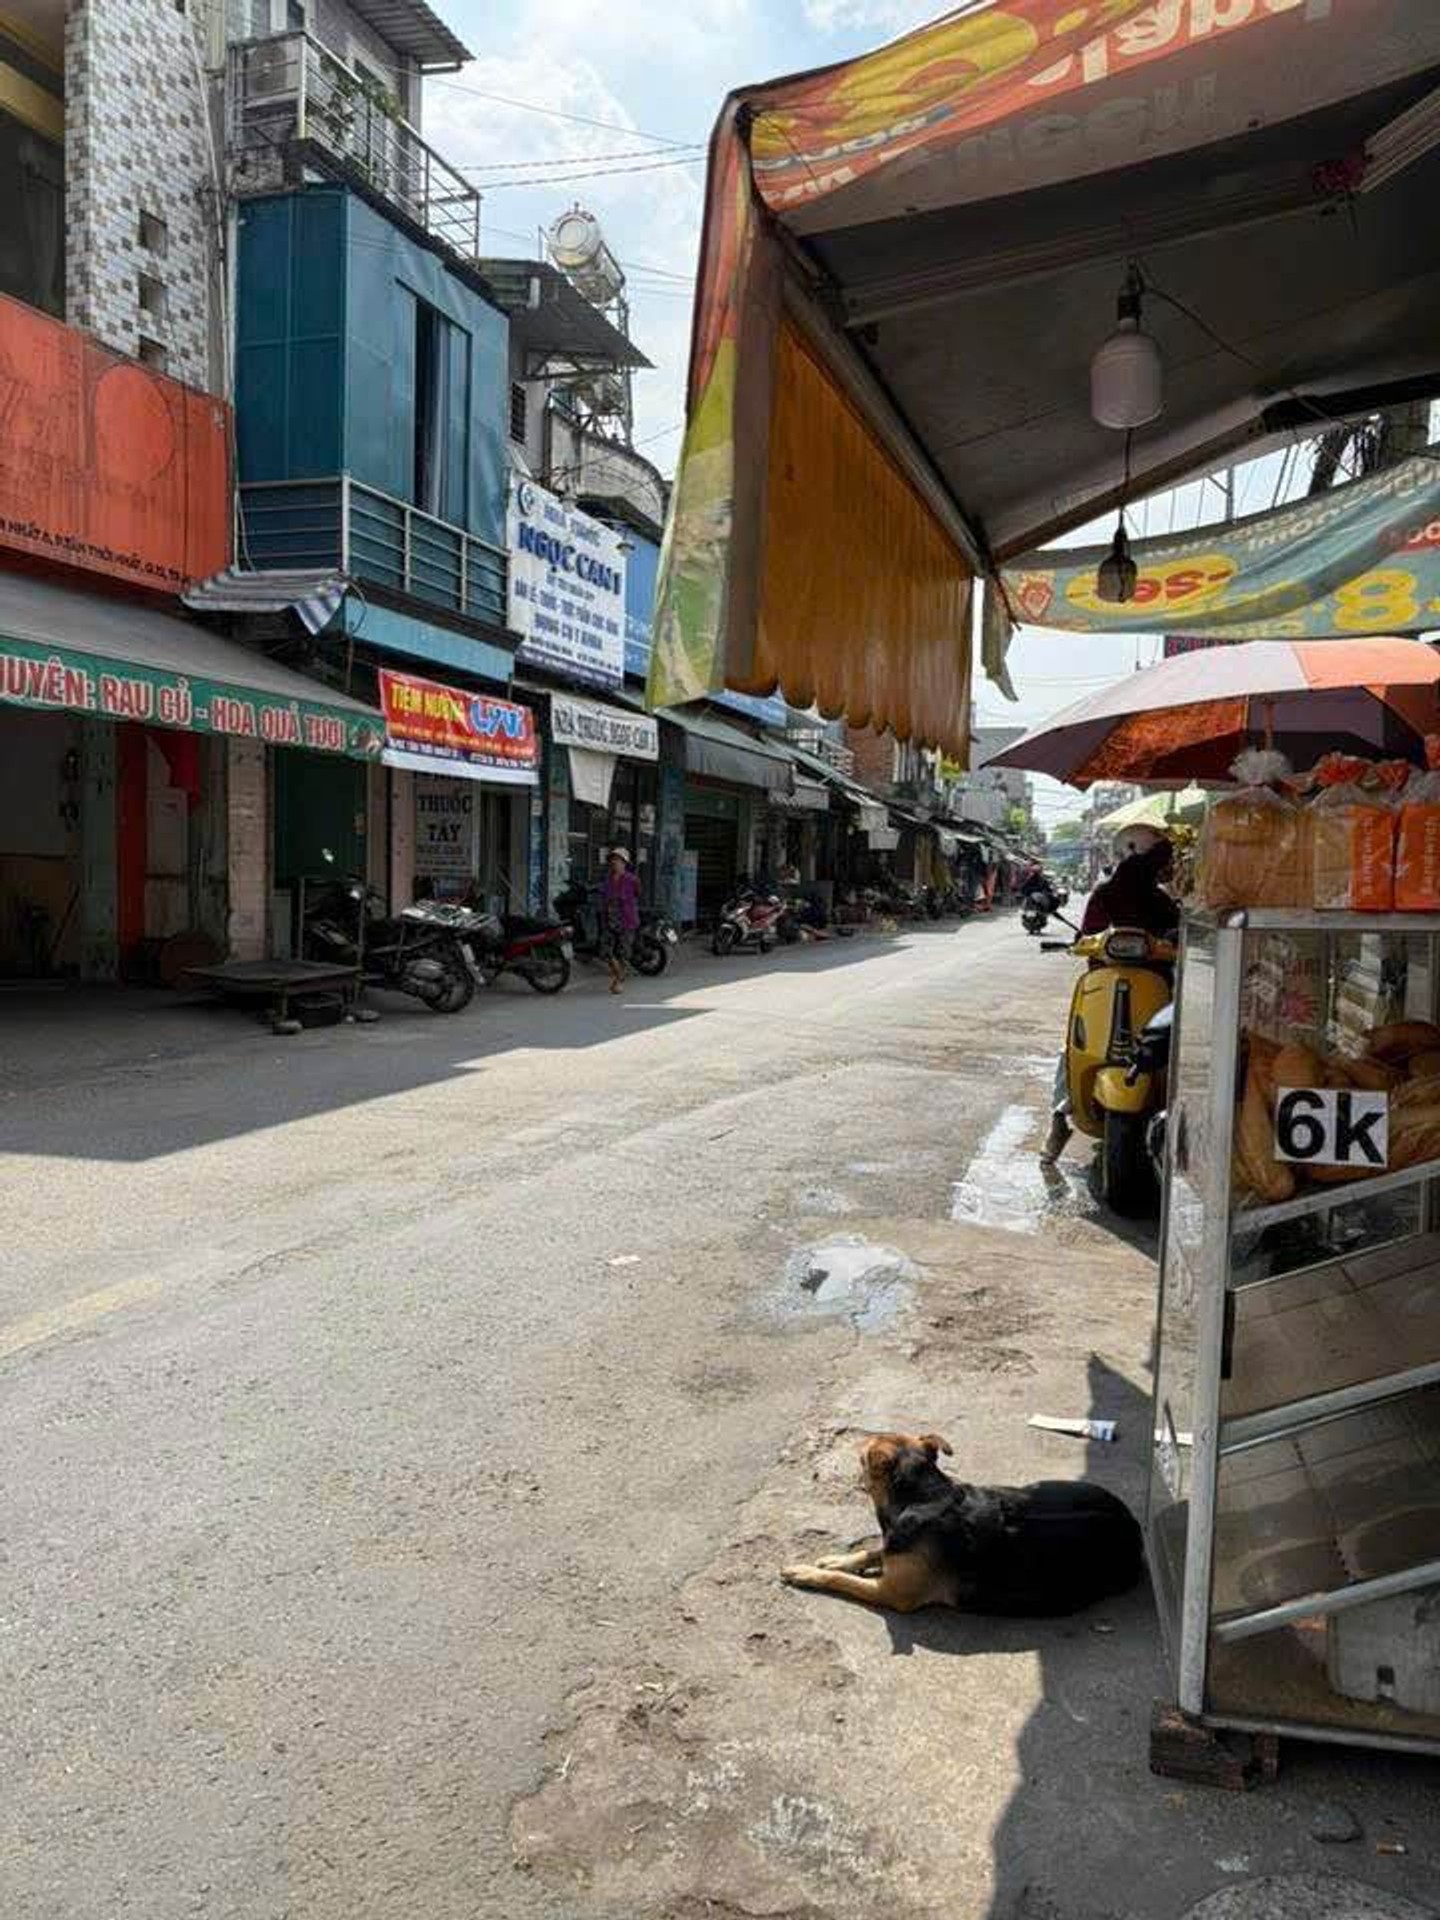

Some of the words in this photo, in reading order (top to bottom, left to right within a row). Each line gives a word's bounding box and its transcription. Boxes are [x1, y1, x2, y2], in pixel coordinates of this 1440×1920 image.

[0, 654, 96, 710] UYÊN:
[101, 673, 154, 720] RAU
[159, 676, 193, 726] CỦ
[211, 696, 256, 737] HOA
[260, 701, 302, 744] QUẢ
[416, 787, 474, 814] THUỐC
[1278, 1090, 1385, 1163] 6k
